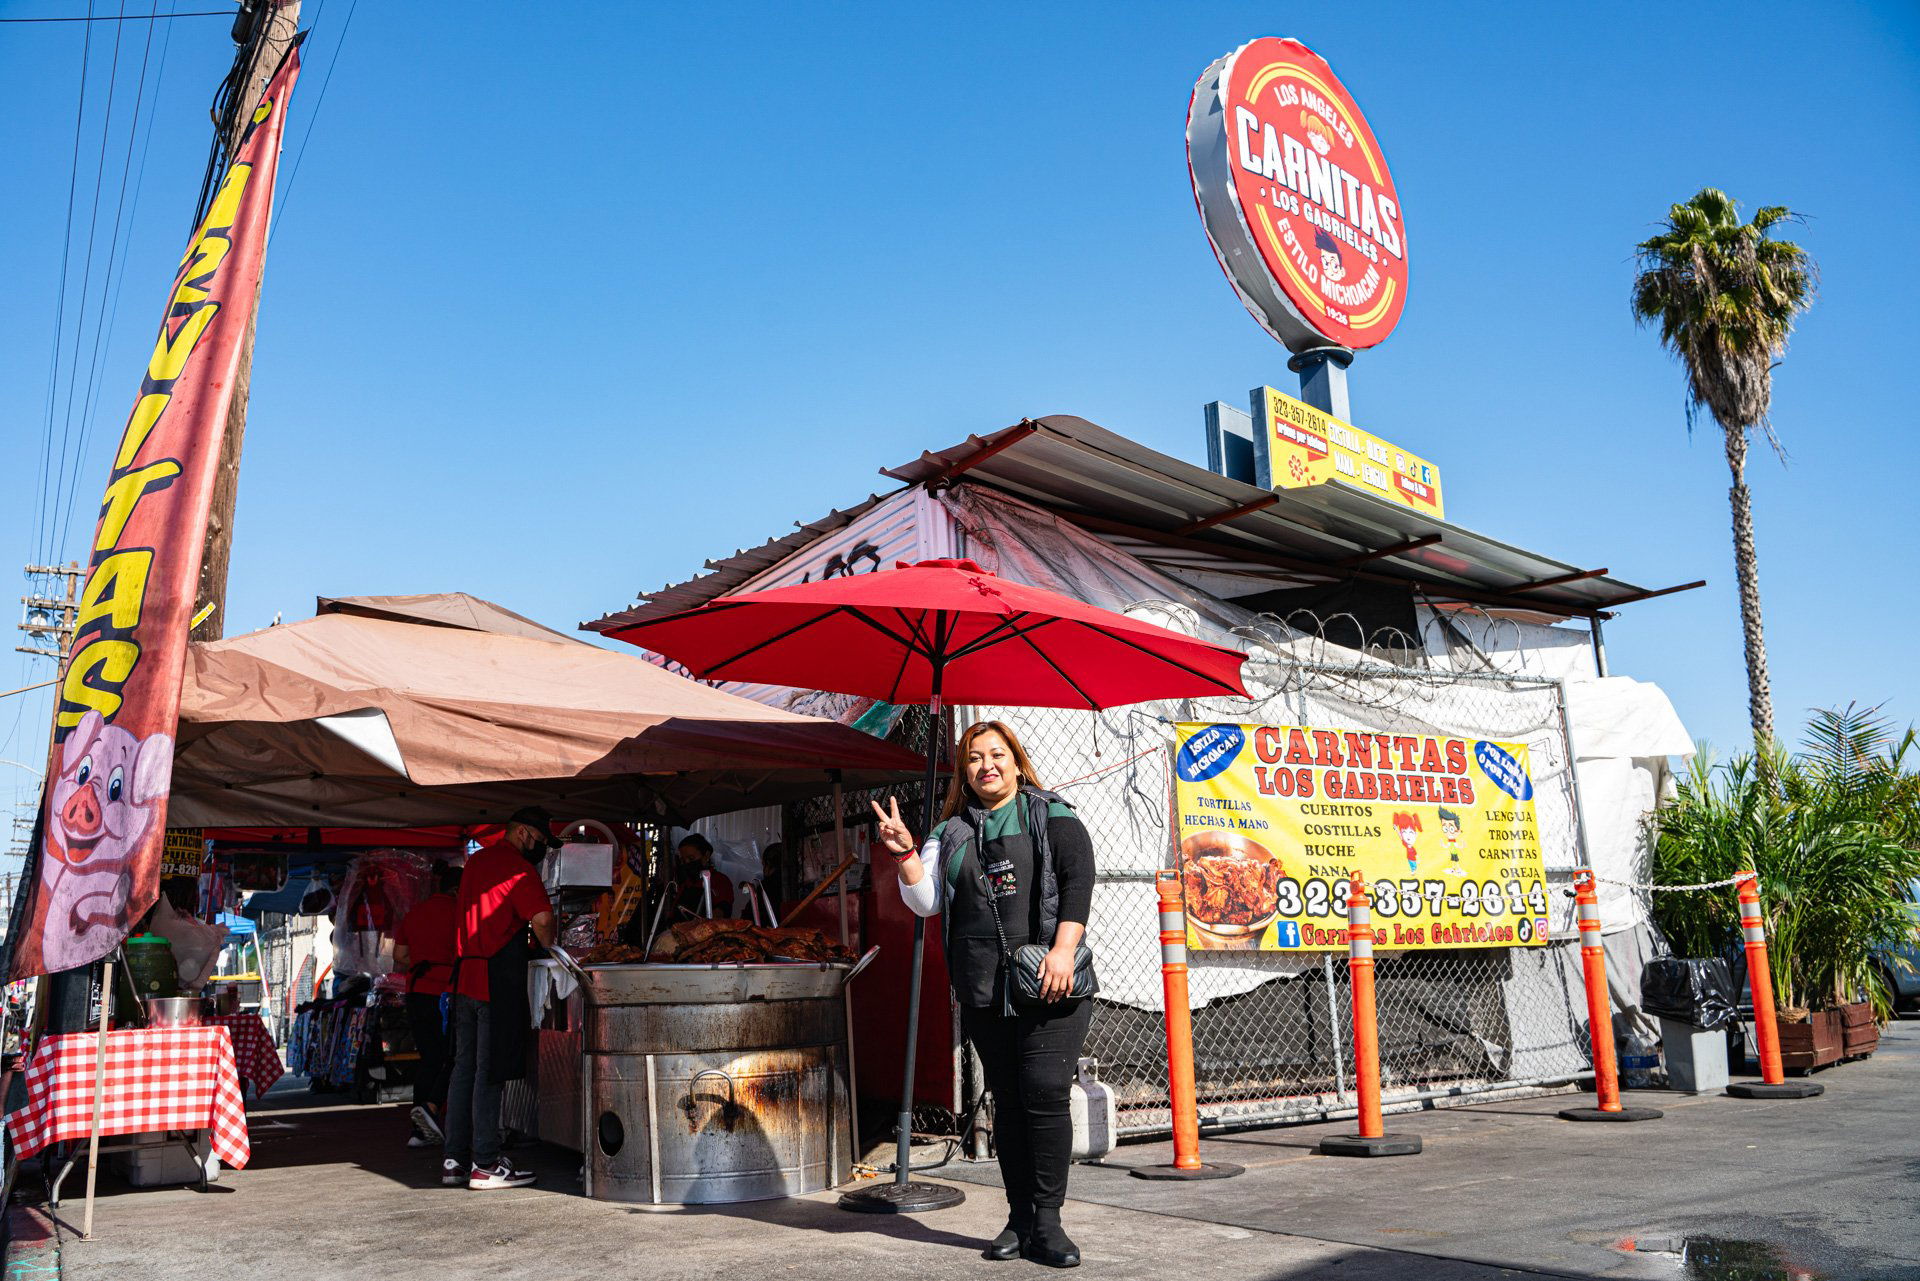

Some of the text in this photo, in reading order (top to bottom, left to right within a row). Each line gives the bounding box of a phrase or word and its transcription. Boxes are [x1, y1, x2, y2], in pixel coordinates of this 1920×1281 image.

[1274, 84, 1354, 148] LOS ANGELES
[1236, 104, 1402, 260] CARNITAS
[1271, 186, 1378, 264] LOS GABRIELES
[1277, 217, 1380, 306] ESTILO MICHOACAN
[1273, 396, 1327, 435] 323-357-2614
[1254, 726, 1468, 775] CARNITAS
[1484, 743, 1501, 763] POR
[1484, 758, 1503, 779] POR
[1254, 767, 1475, 805] LOS GABRIELES
[1197, 797, 1252, 811] TORTILLAS
[1300, 803, 1373, 817] CUERITOS
[1184, 815, 1269, 829] HECHAS A MANO
[1485, 811, 1532, 822] LENGUA
[1304, 824, 1381, 837] COSTILLAS
[1489, 829, 1535, 840] TROMPA
[1304, 844, 1355, 856] BUCHE
[1479, 848, 1537, 859] CARNITAS
[1309, 865, 1351, 877] NANA
[1500, 867, 1540, 878] OREJA
[1301, 922, 1513, 945] Carnas Los Gabrieles
